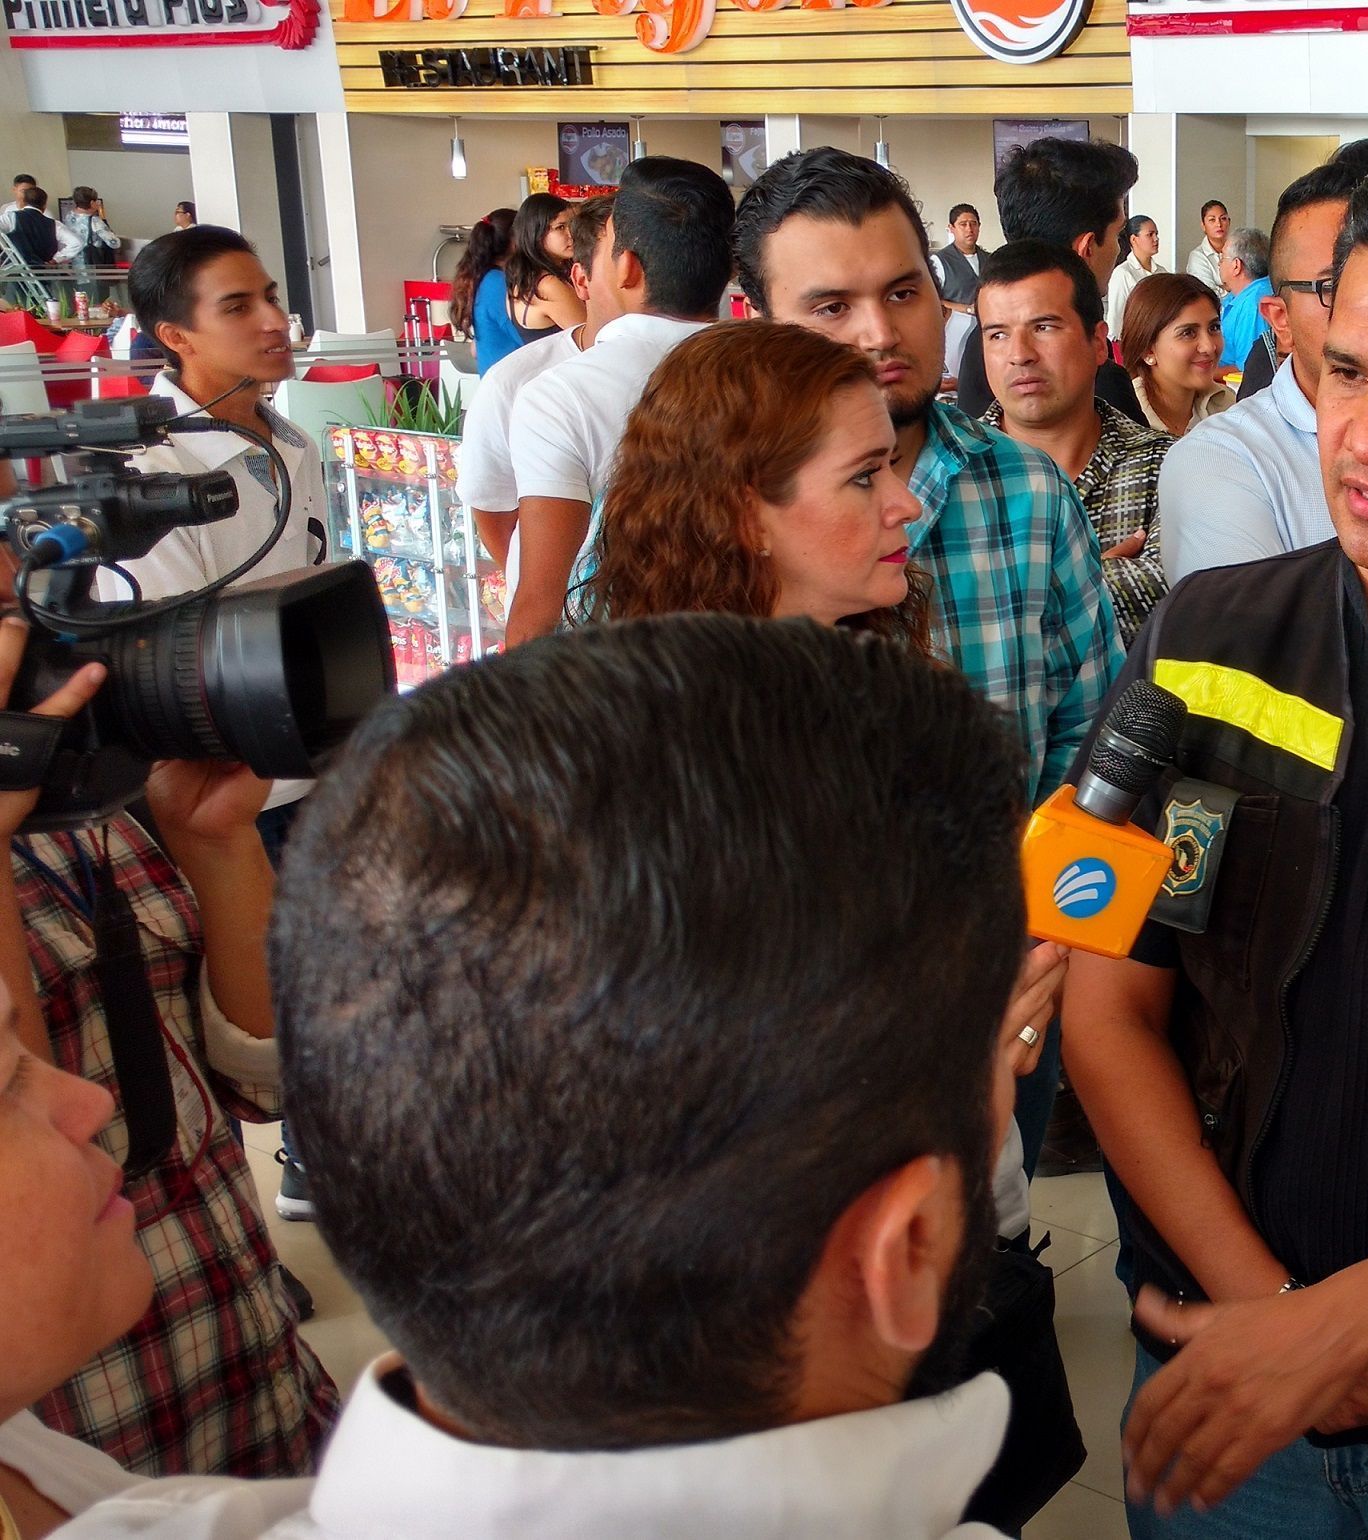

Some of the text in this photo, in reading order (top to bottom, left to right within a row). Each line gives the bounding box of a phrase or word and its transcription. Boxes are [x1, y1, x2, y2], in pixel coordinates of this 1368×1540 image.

[379, 46, 598, 87] RESTAURANT
[582, 126, 600, 138] Pollo
[601, 126, 626, 138] Asado
